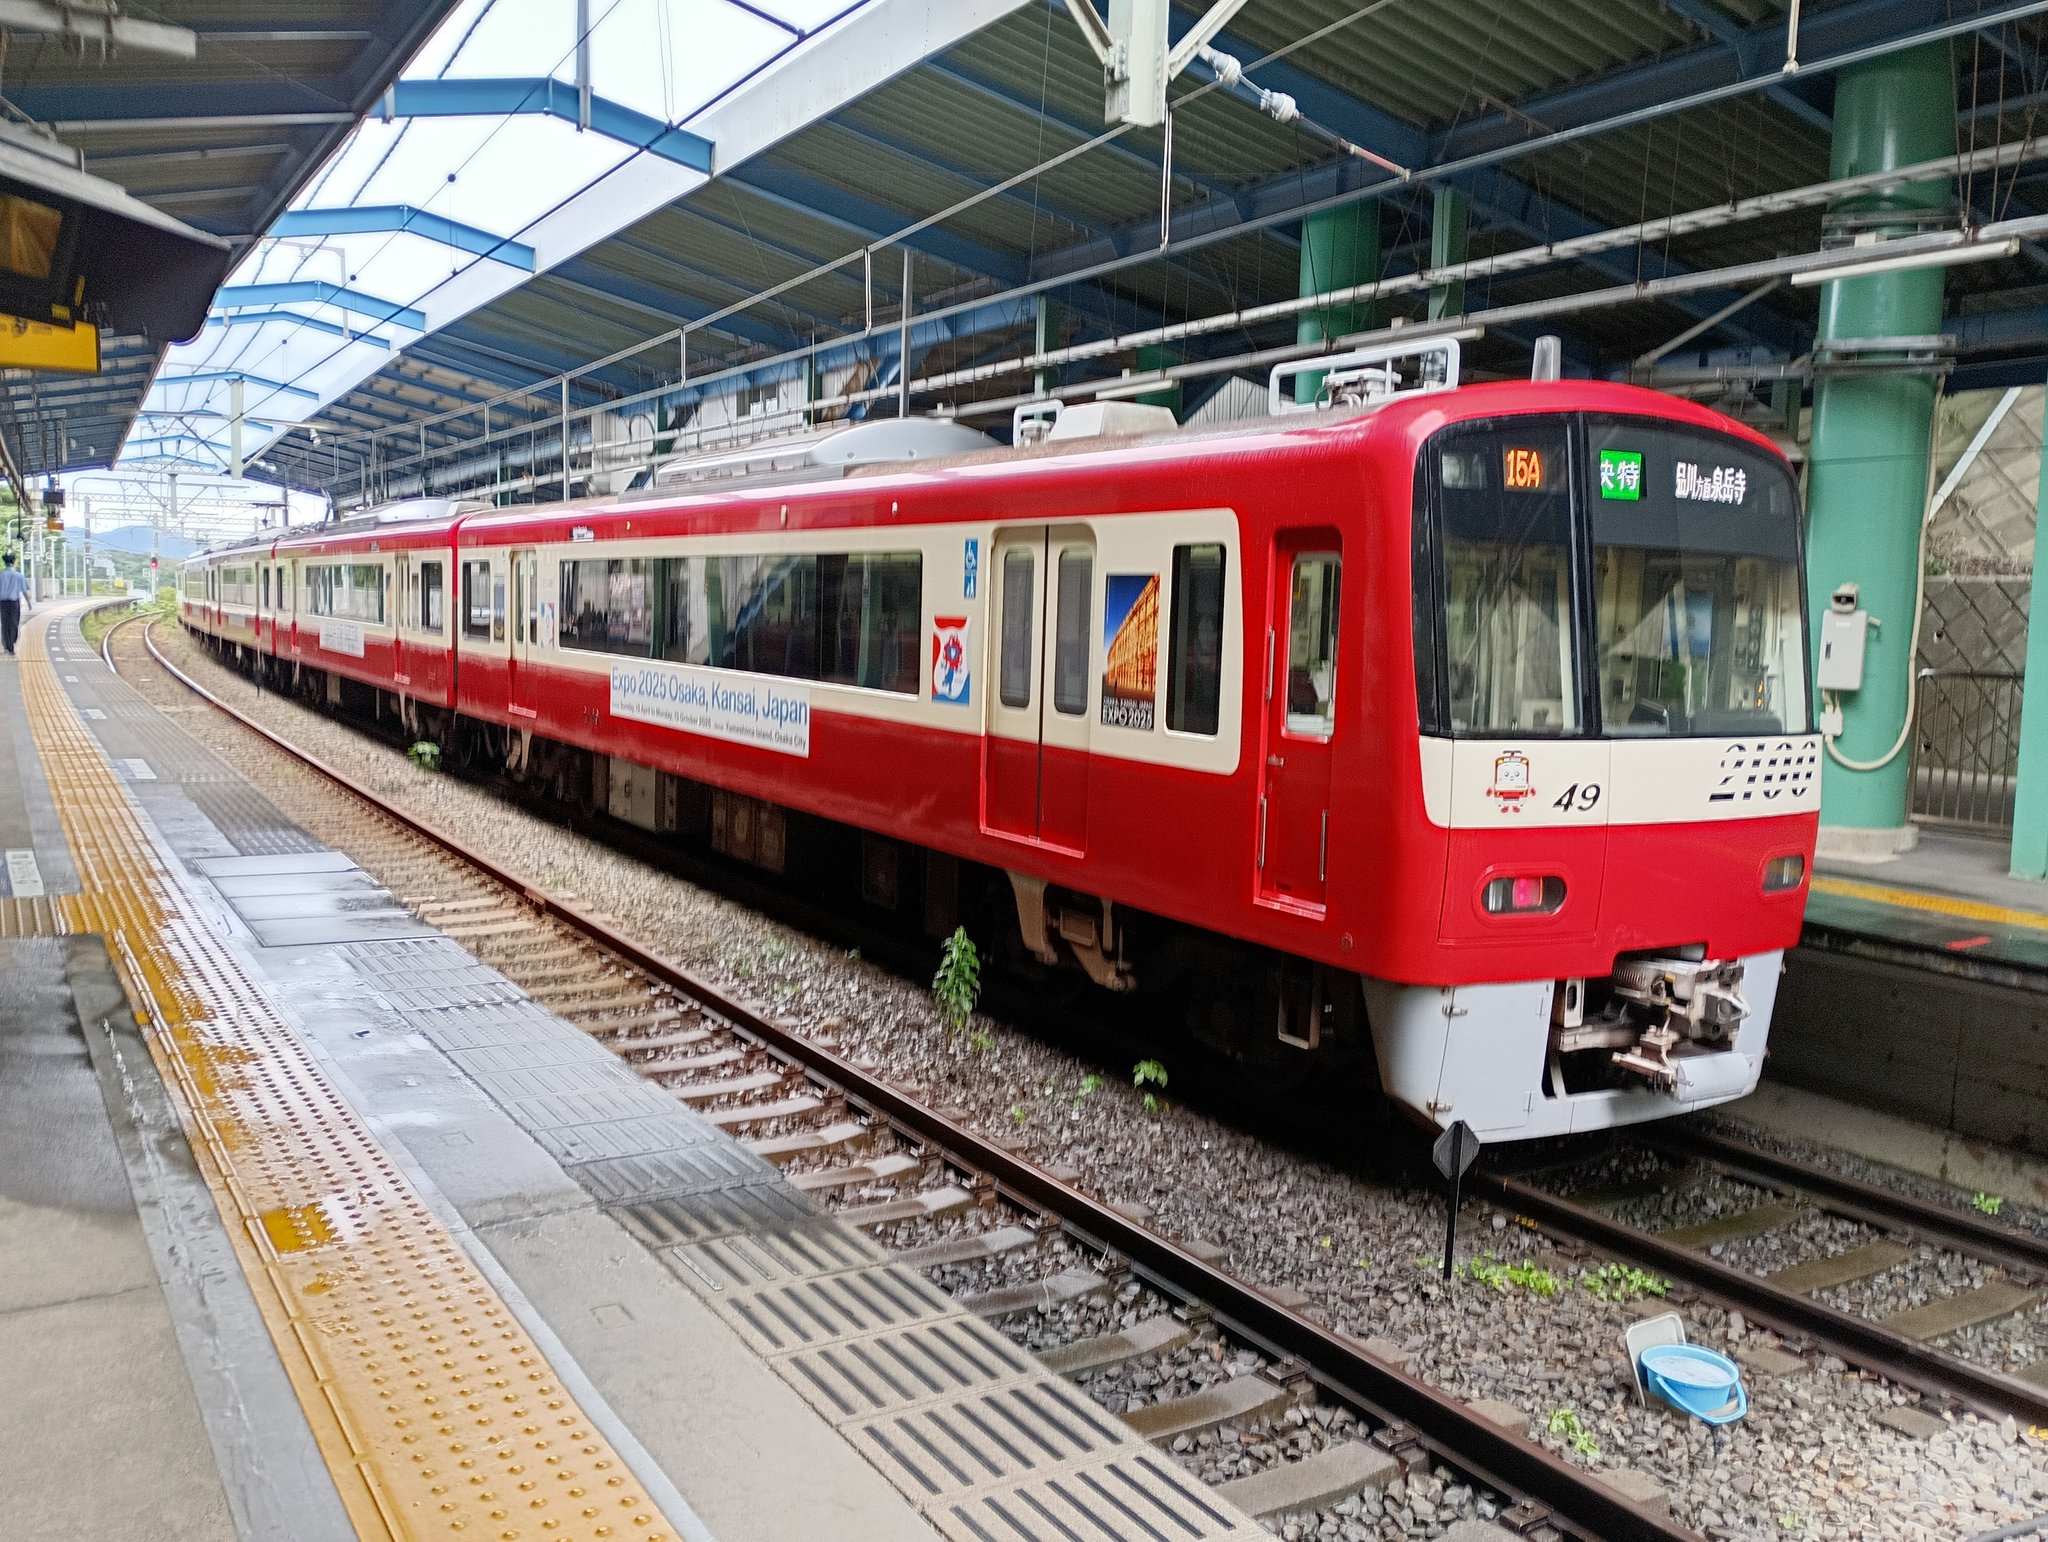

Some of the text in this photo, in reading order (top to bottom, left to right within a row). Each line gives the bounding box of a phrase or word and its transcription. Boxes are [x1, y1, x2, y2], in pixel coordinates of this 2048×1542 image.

[1507, 449, 1540, 488] 15A
[612, 666, 808, 729] Expo 2025 Osaka, Kansai, Japan
[1103, 705, 1152, 729] EXPO 2025
[1708, 740, 1816, 803] 2100
[1552, 783, 1601, 812] 49
